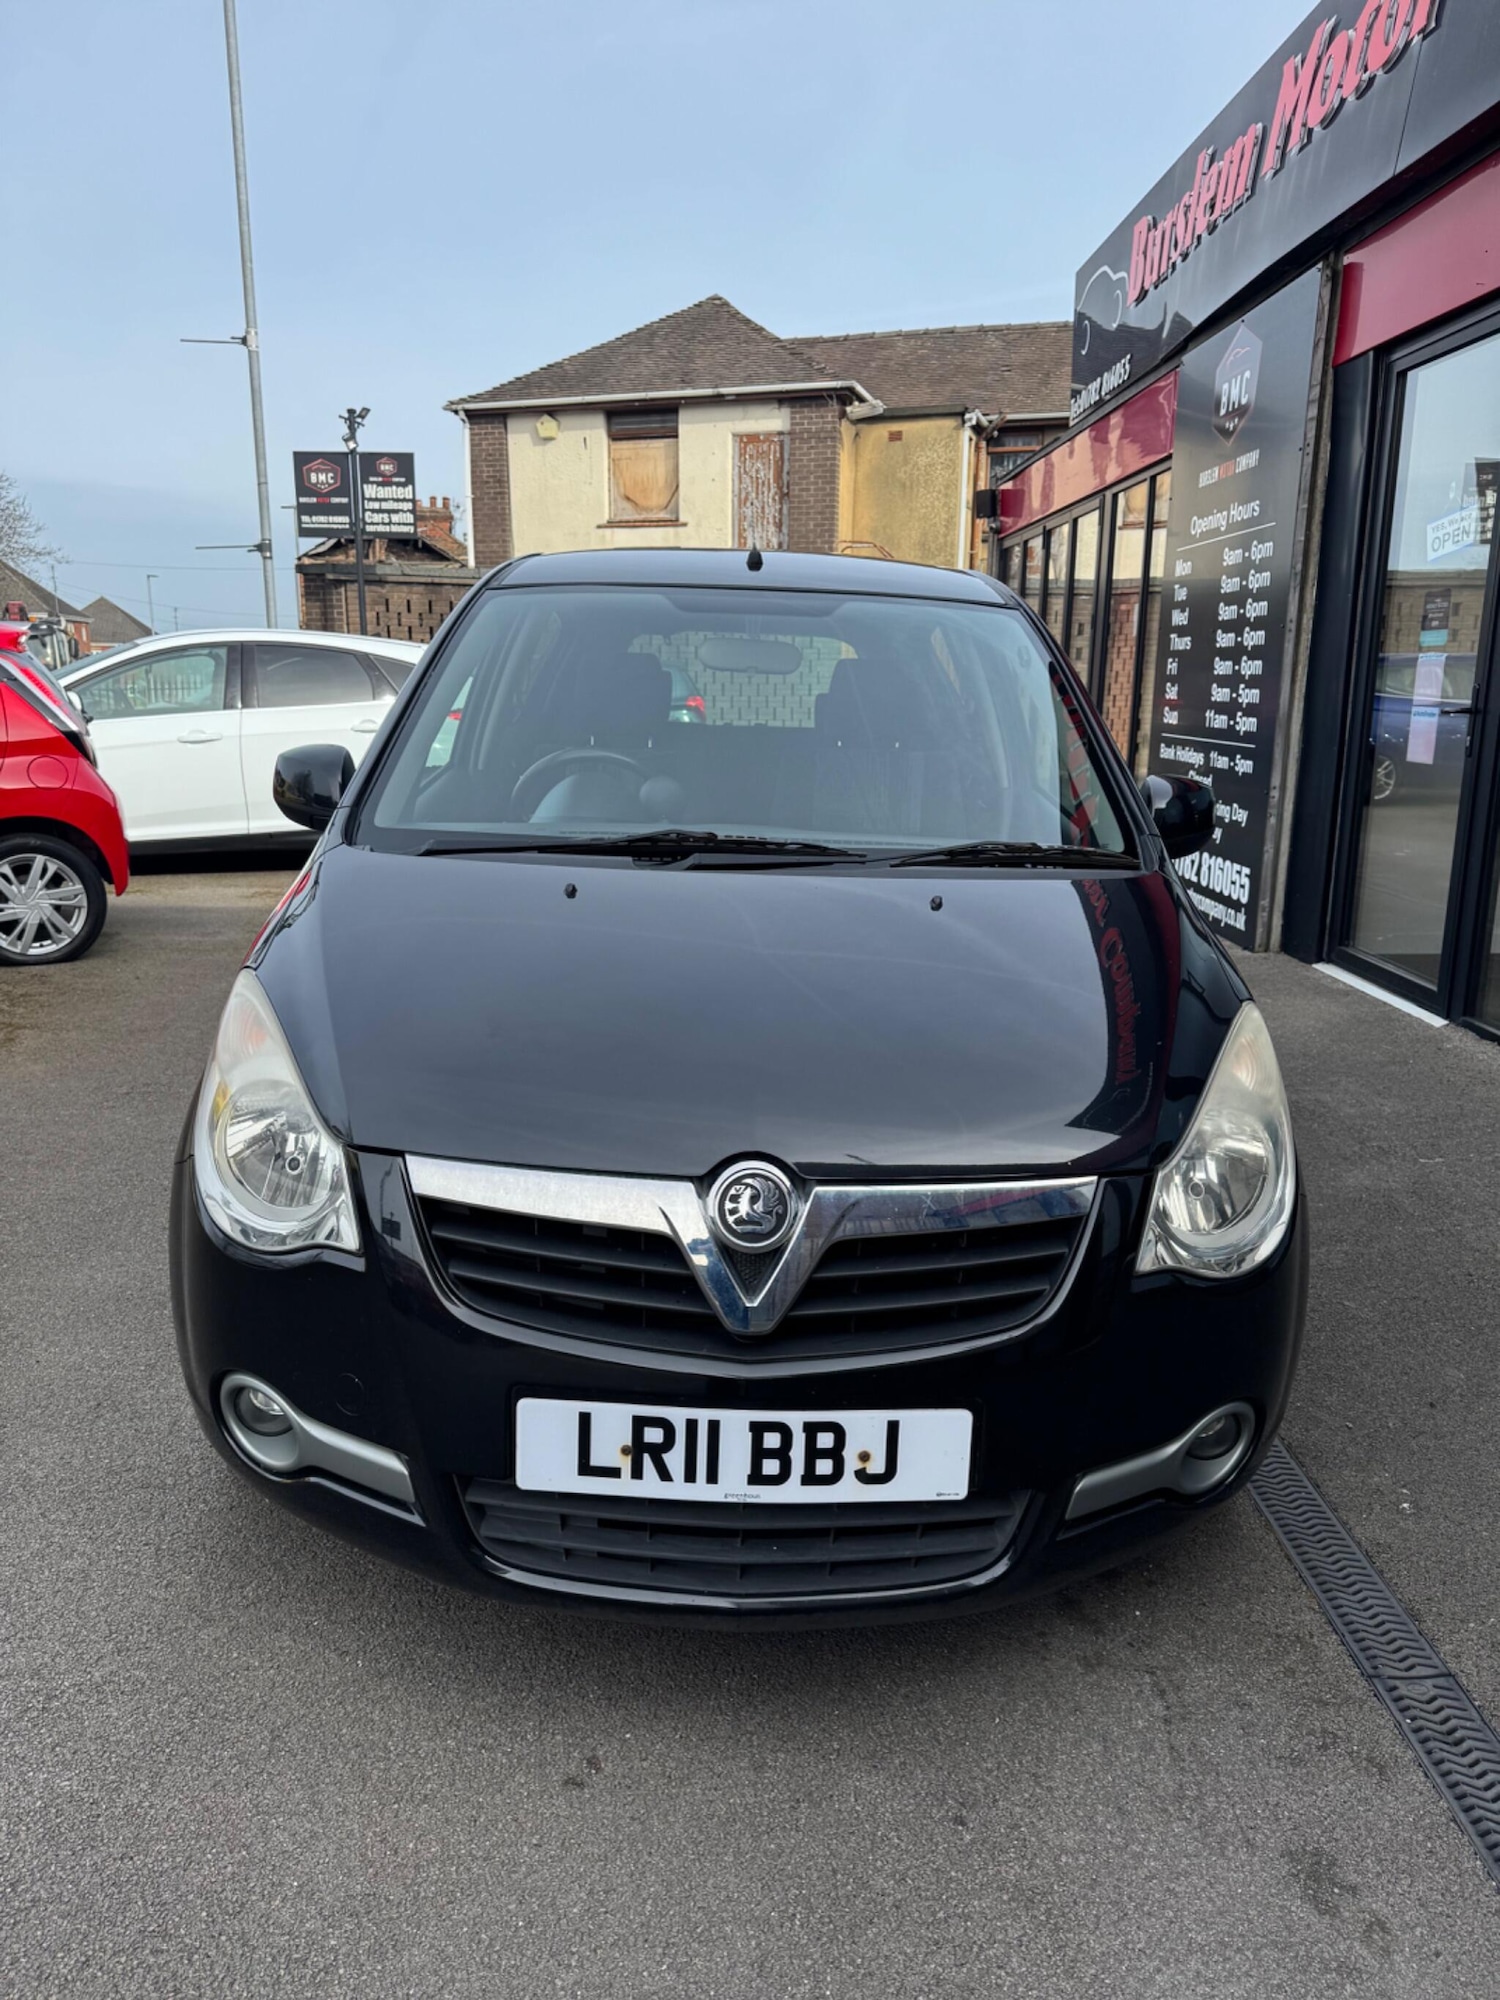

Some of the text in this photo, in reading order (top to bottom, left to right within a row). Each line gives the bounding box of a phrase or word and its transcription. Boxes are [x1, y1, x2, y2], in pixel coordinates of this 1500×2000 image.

[1126, 122, 1262, 308] Burslem
[1219, 370, 1251, 417] BMC
[310, 472, 335, 484] BMC
[363, 484, 413, 499] Wanted
[364, 500, 413, 511] Low mileage
[364, 511, 414, 523] Cars with
[1190, 500, 1260, 538] Opening Hours
[366, 524, 414, 534] service history
[1431, 522, 1471, 553] OPEN
[1175, 559, 1192, 577] Mon
[1223, 547, 1243, 566] 9am
[1250, 540, 1274, 564] 6pm
[1174, 584, 1188, 602] Tue
[1220, 575, 1240, 594] 9am
[1248, 569, 1271, 593] 6pm
[1171, 607, 1189, 627] Wed
[1218, 602, 1238, 621] 9am
[1245, 598, 1268, 622] 6pm
[1170, 633, 1192, 651] Thurs
[1216, 629, 1236, 648] 9am
[1243, 626, 1265, 651] 6pm
[1166, 658, 1178, 675] Fri
[1213, 657, 1233, 675] 9am
[1240, 655, 1263, 680] 6pm
[1165, 682, 1178, 700] Sat
[1211, 683, 1231, 702] 9am
[1238, 684, 1260, 708] 5pm
[1163, 706, 1178, 725] Sun
[1205, 709, 1228, 729] 11am
[1235, 711, 1258, 736] 5pm
[1160, 743, 1175, 760] Bank
[1176, 745, 1205, 768] Holidays
[1209, 750, 1229, 770] 11am
[1235, 753, 1254, 776] 5pm
[1231, 802, 1249, 828] Day
[1200, 851, 1251, 905] 816055
[577, 1411, 901, 1487] LR11 BBJ
